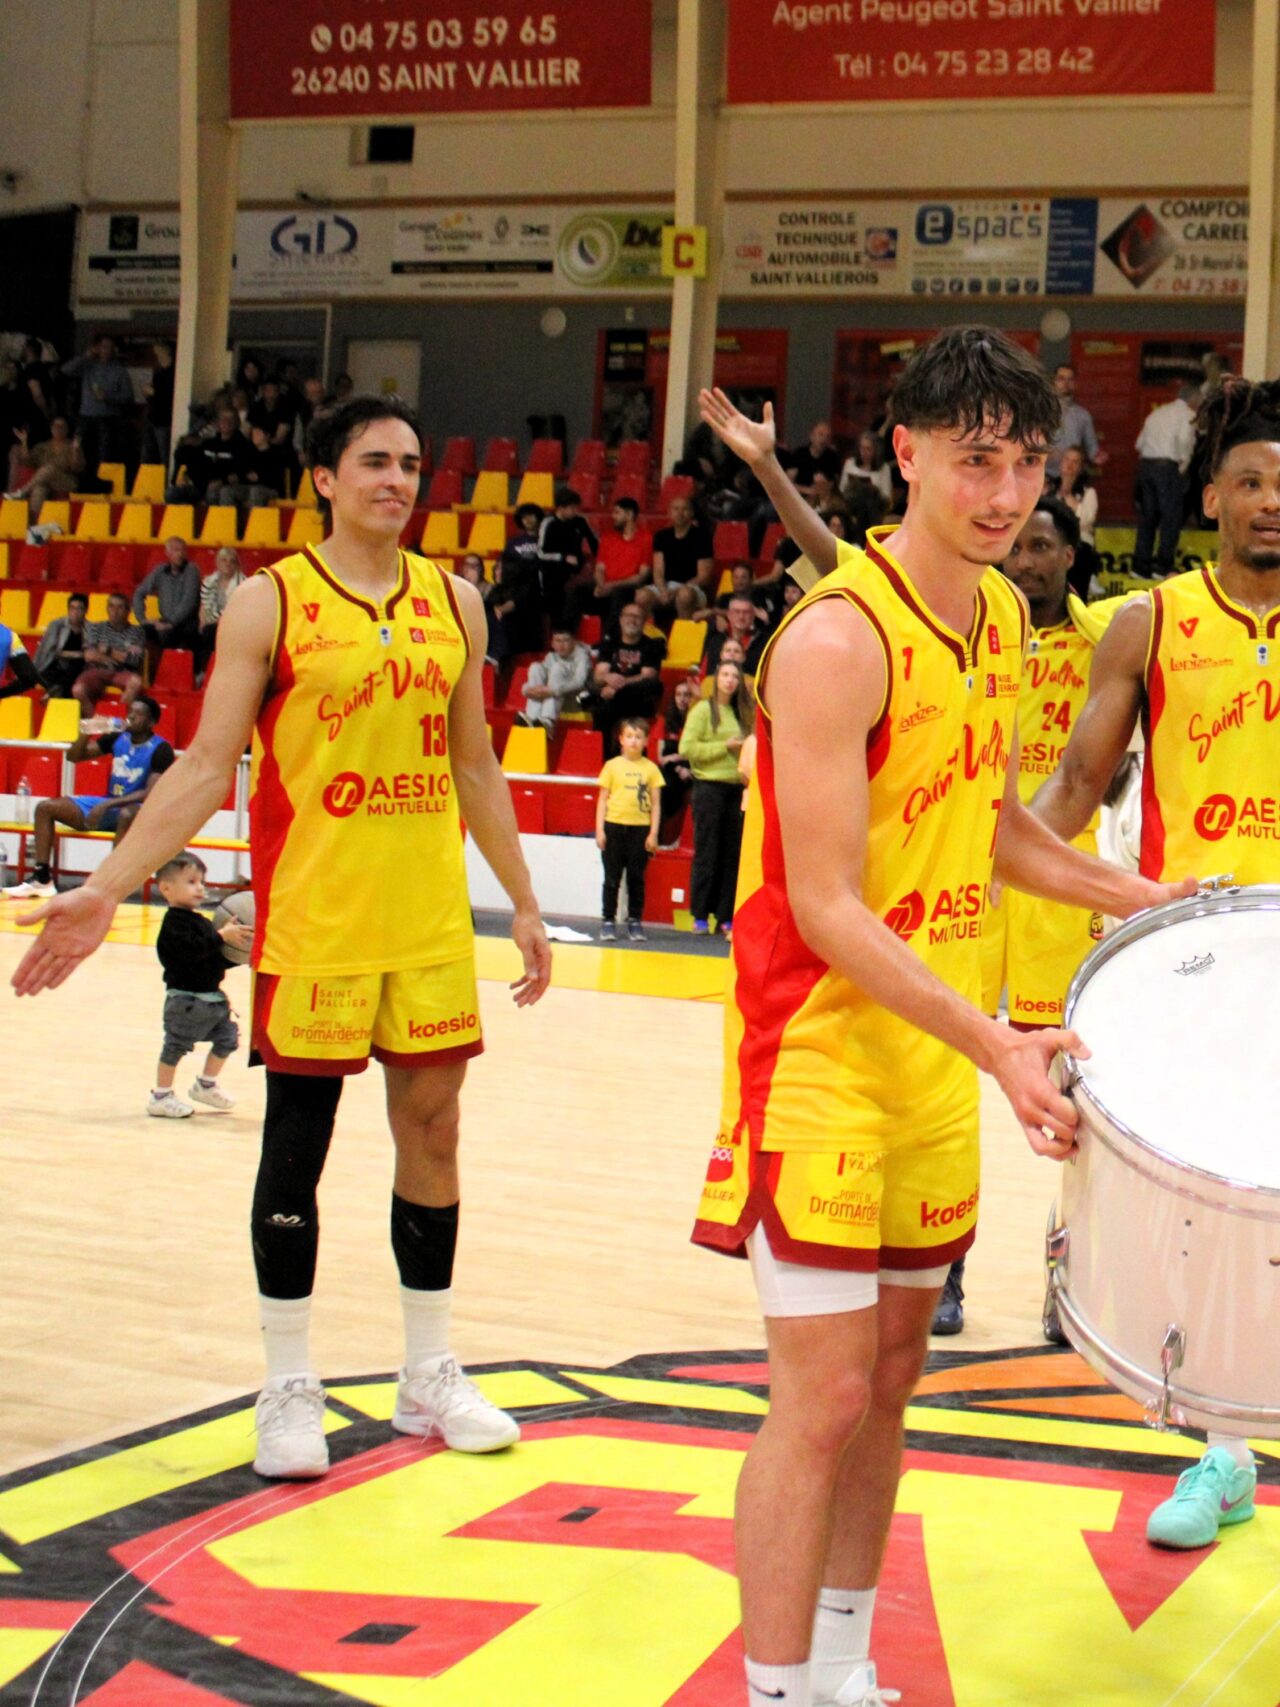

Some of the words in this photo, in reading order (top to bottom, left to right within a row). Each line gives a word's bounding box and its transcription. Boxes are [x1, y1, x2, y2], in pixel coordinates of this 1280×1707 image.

[772, 1, 852, 30] Agent
[861, 0, 978, 26] Peugeot
[988, 0, 1062, 19] Saint
[340, 22, 373, 51] 04
[384, 21, 418, 50] 75
[426, 19, 463, 48] 03
[473, 17, 508, 47] 59
[520, 15, 557, 45] 65
[291, 65, 370, 95] 26240
[377, 62, 457, 92] SAINT
[466, 58, 581, 88] VALLIER
[834, 53, 872, 79] Tél
[893, 51, 928, 77] 04
[935, 50, 968, 76] 75
[975, 49, 1010, 75] 23
[1017, 48, 1052, 74] 28
[1059, 46, 1095, 73] 42
[778, 211, 855, 226] CONTROLE
[673, 233, 695, 268] C
[776, 231, 858, 246] TECHNIQUE
[768, 251, 862, 266] AUTOMOBILE
[1041, 701, 1071, 733] 24
[419, 713, 447, 757] 13
[1015, 994, 1063, 1014] koesi
[408, 1011, 478, 1040] koesio
[921, 1182, 981, 1229] koesi
